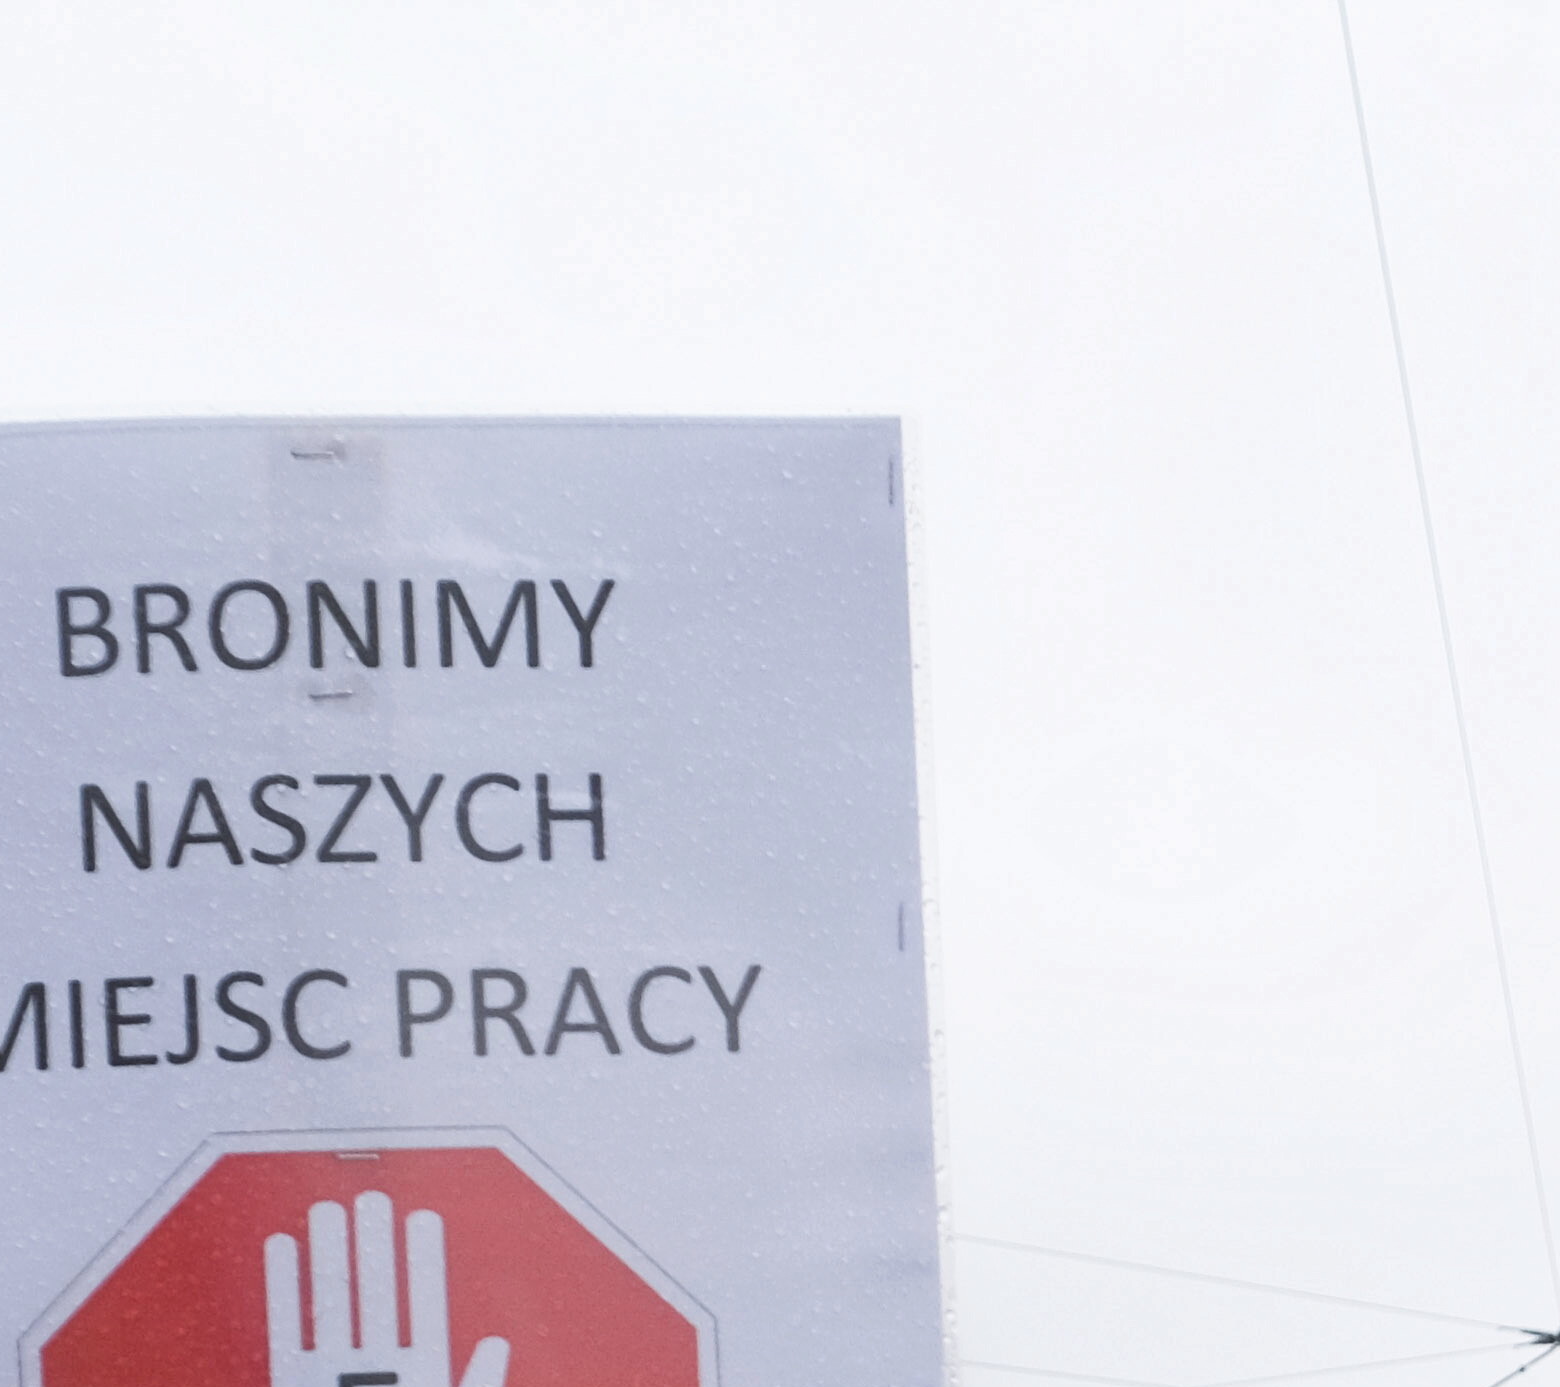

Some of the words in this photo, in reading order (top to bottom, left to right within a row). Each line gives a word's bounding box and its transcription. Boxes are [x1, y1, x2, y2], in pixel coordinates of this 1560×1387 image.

[55, 578, 616, 676] BRONIMY
[81, 774, 607, 872] NASZYCH
[397, 964, 763, 1057] PRACY
